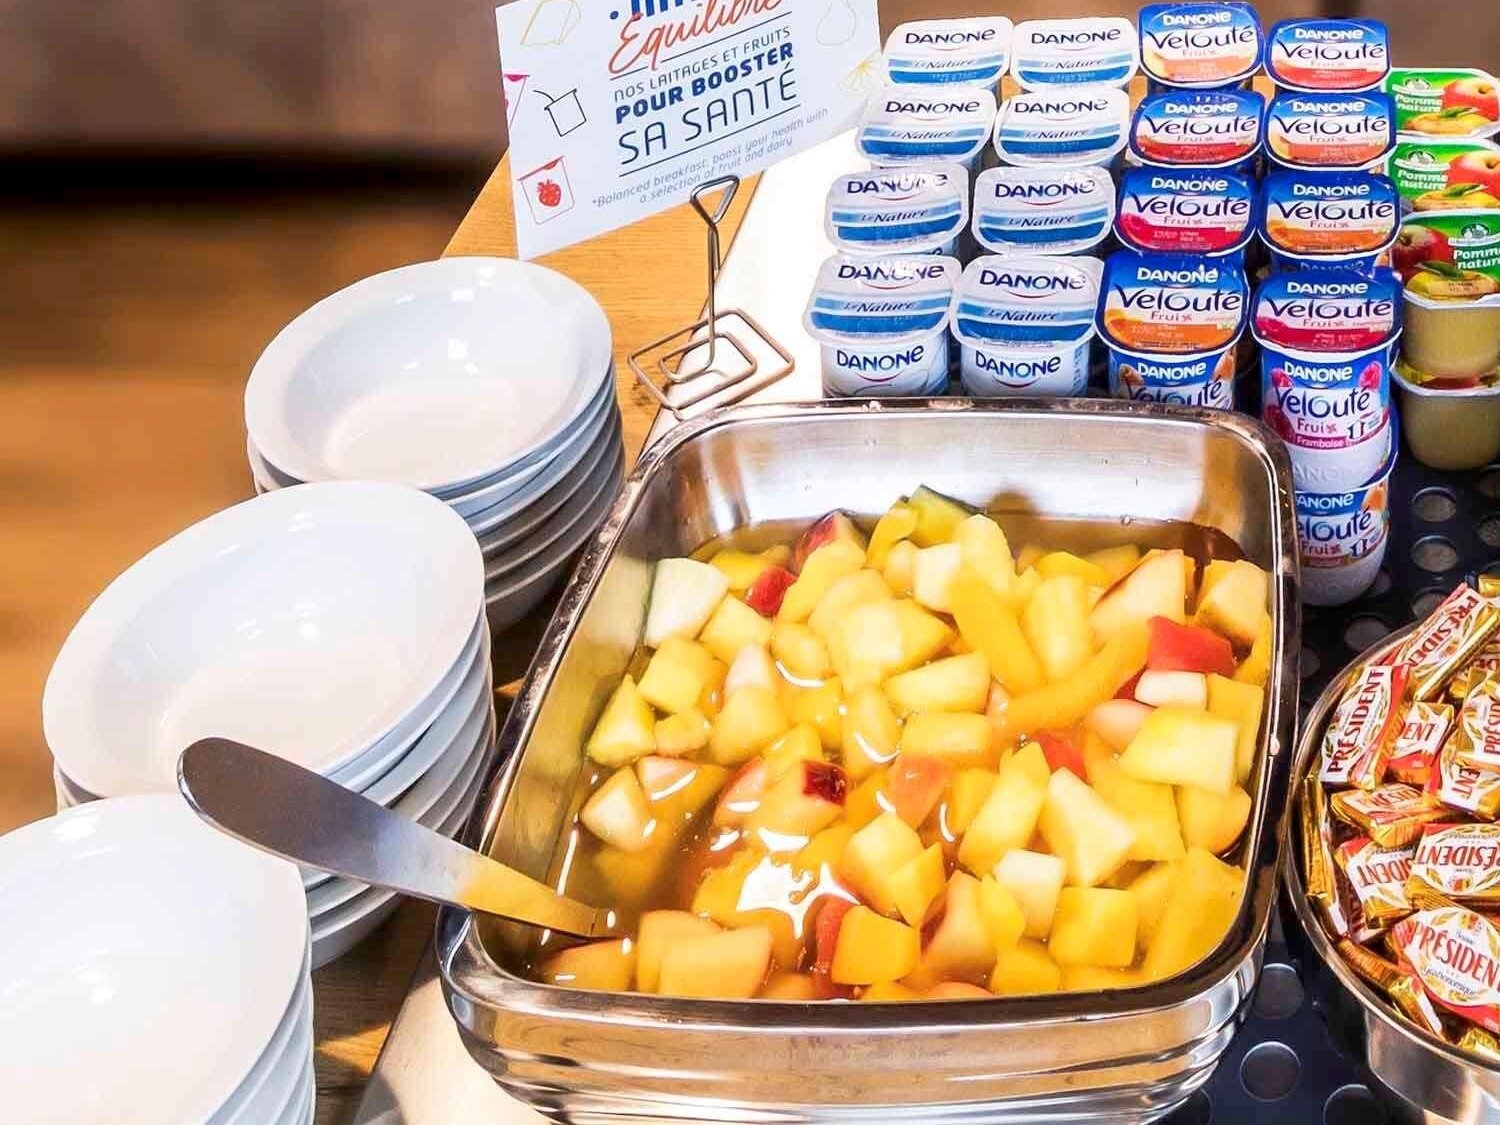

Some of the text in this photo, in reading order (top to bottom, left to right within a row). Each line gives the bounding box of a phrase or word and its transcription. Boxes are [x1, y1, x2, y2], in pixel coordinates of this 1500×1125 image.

[1277, 43, 1384, 60] Velouté
[615, 27, 790, 102] NOS LAITAGES ET FRUITS
[617, 43, 793, 124] POUR BOOSTER
[1396, 94, 1442, 105] Pomme
[1396, 103, 1441, 112] nature
[619, 62, 797, 165] SA SANTÉ
[806, 108, 828, 124] with
[1144, 113, 1257, 136] Velouté
[1398, 170, 1448, 183] Pomme
[1400, 179, 1448, 190] nature
[1131, 193, 1248, 219] Velouté
[1274, 198, 1393, 220] Velouté
[1114, 283, 1241, 311] Velouté
[1265, 295, 1392, 319] Velouté
[1276, 386, 1370, 419] Velouté
[1297, 435, 1345, 447] Framboise
[1326, 666, 1383, 775] PRÉSIDENT
